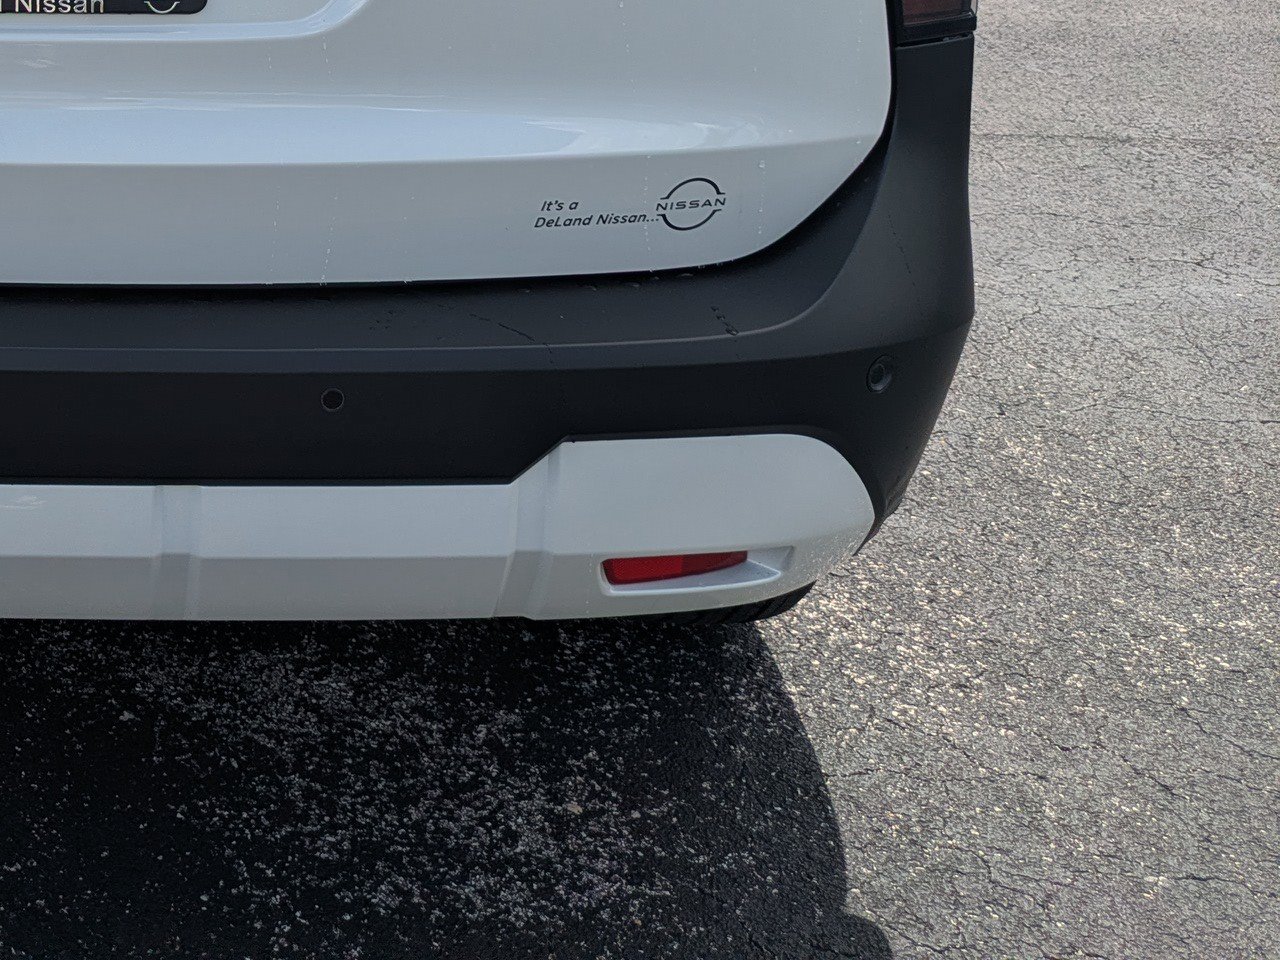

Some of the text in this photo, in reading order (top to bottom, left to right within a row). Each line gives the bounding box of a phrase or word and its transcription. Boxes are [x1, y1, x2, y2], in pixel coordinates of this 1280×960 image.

[540, 199, 580, 212] It's a
[655, 197, 727, 212] NISSAN
[534, 212, 660, 229] DeLand Nissan...
